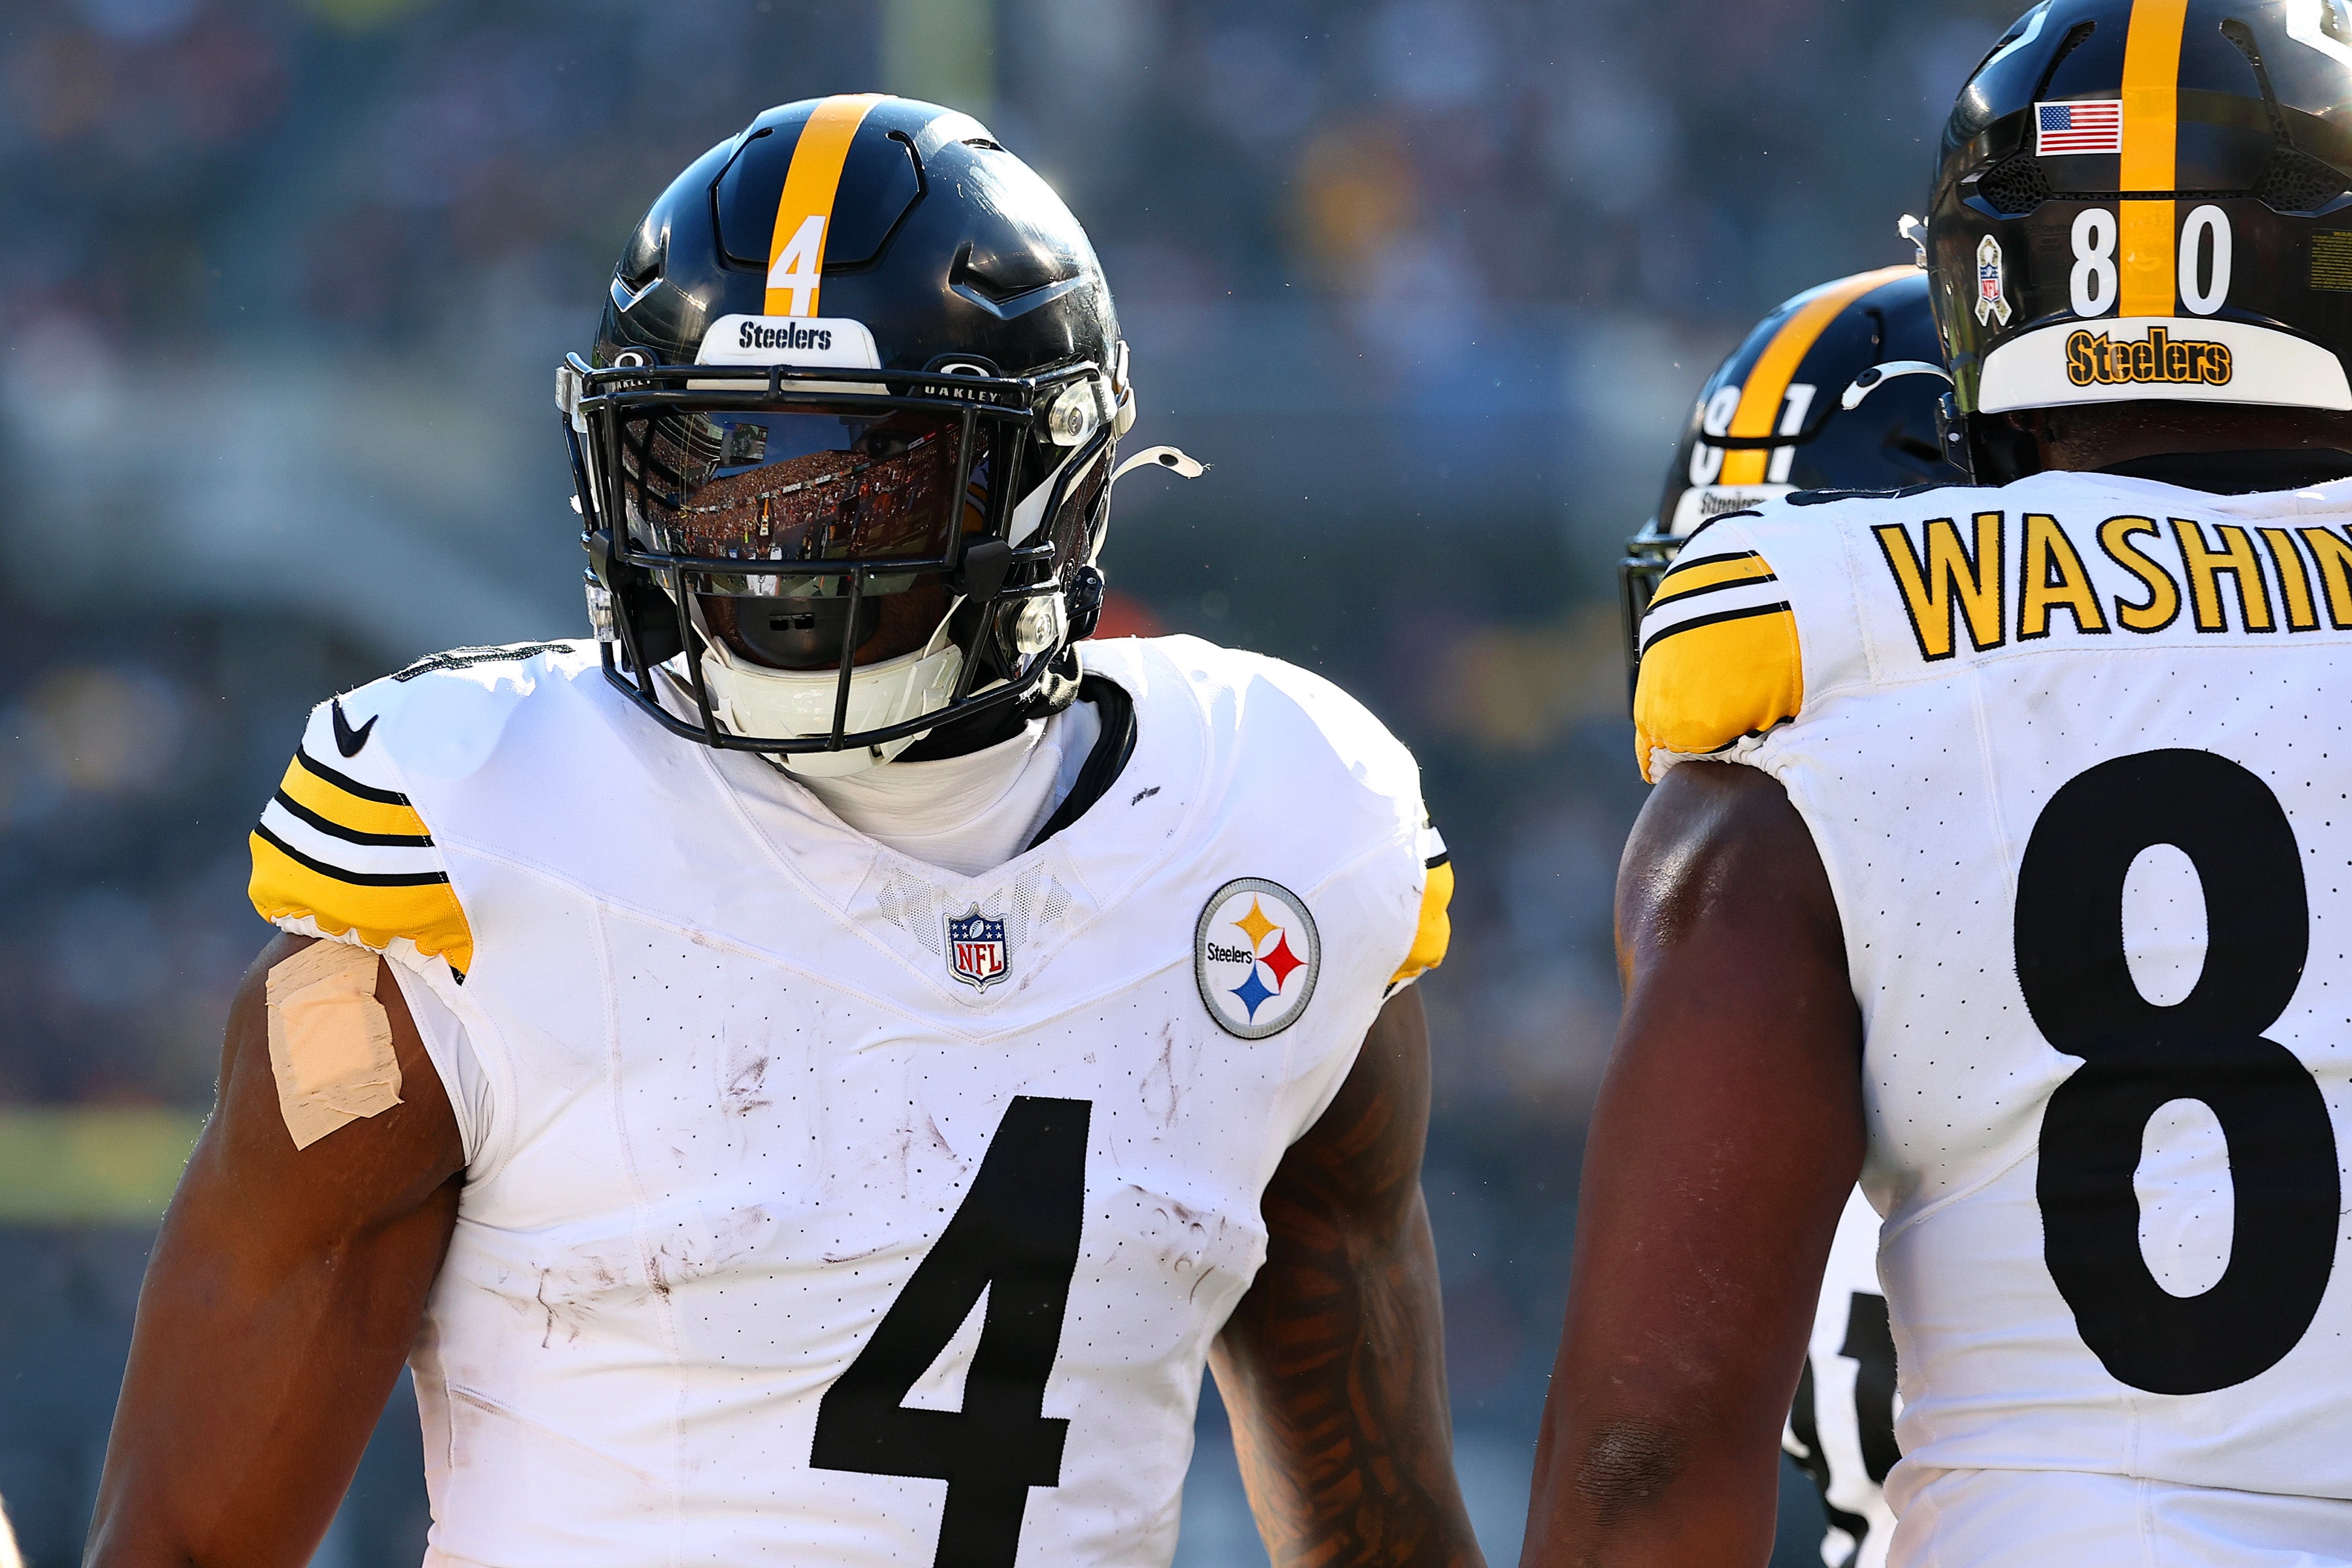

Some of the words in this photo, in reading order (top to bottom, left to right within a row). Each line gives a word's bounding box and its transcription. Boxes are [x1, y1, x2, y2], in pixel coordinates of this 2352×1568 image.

[766, 215, 826, 317] 4
[1982, 280, 1999, 299] NFL
[739, 321, 832, 351] Steelers
[2066, 327, 2232, 386] Steelers
[925, 385, 998, 402] OAKLEY
[1689, 383, 1817, 487] 91
[956, 943, 1002, 976] NFL
[1207, 943, 1252, 964] Steelers
[2014, 748, 2341, 1395] 8
[809, 1095, 1093, 1568] 4
